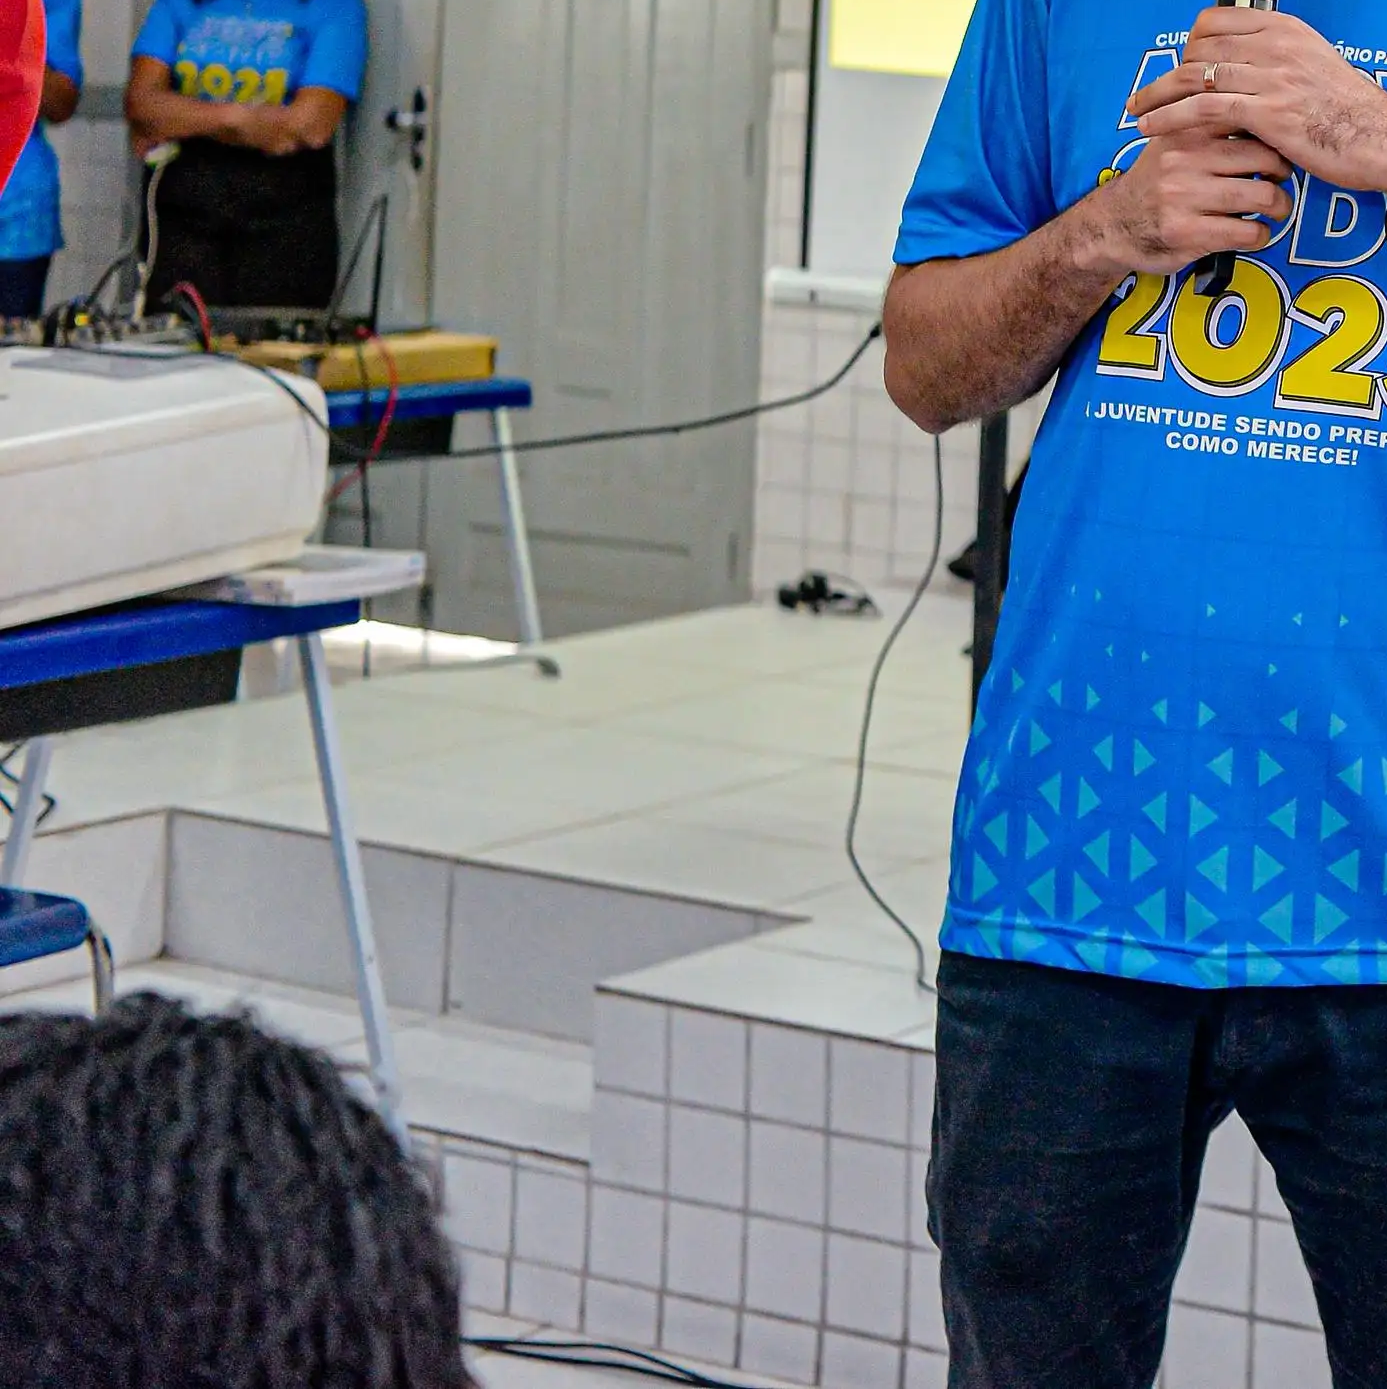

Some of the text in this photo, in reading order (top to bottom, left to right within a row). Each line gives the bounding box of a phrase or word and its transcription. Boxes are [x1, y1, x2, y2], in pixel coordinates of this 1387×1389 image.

[1094, 402, 1228, 431] JUVENTUDE
[1235, 416, 1321, 440] SENDO
[1166, 431, 1359, 466] COMO MERECE!
